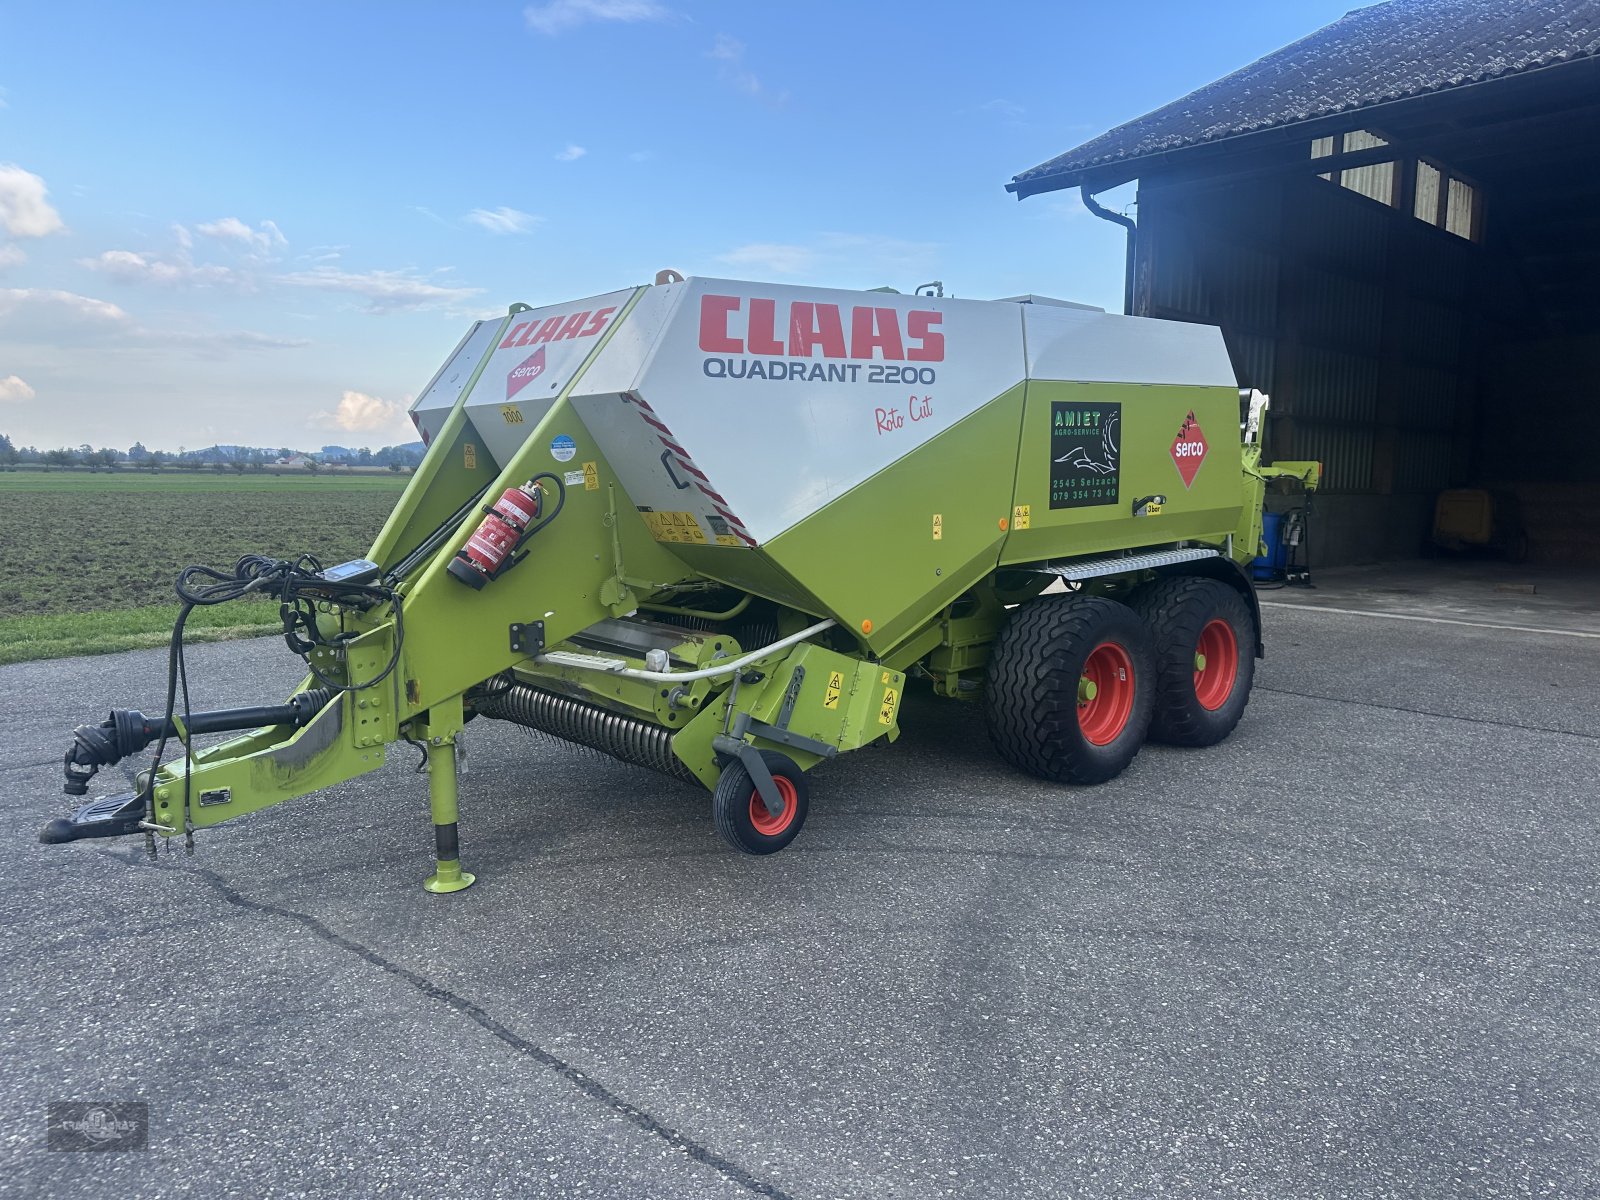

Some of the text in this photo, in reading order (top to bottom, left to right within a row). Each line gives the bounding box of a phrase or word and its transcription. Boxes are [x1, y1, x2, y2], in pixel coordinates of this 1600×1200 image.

[498, 306, 618, 349] CLAAS
[699, 294, 945, 362] CLAAS
[511, 366, 541, 379] serco
[703, 358, 936, 385] QUADRANT 2200
[503, 410, 523, 423] 1000
[875, 395, 933, 435] Roto Cut
[1055, 411, 1100, 426] AMIET
[1055, 428, 1100, 436] AGRO-SERVICE
[1175, 442, 1204, 457] serco
[1053, 477, 1117, 488] 2545 Selzach
[1053, 488, 1116, 501] 079 354 73 40
